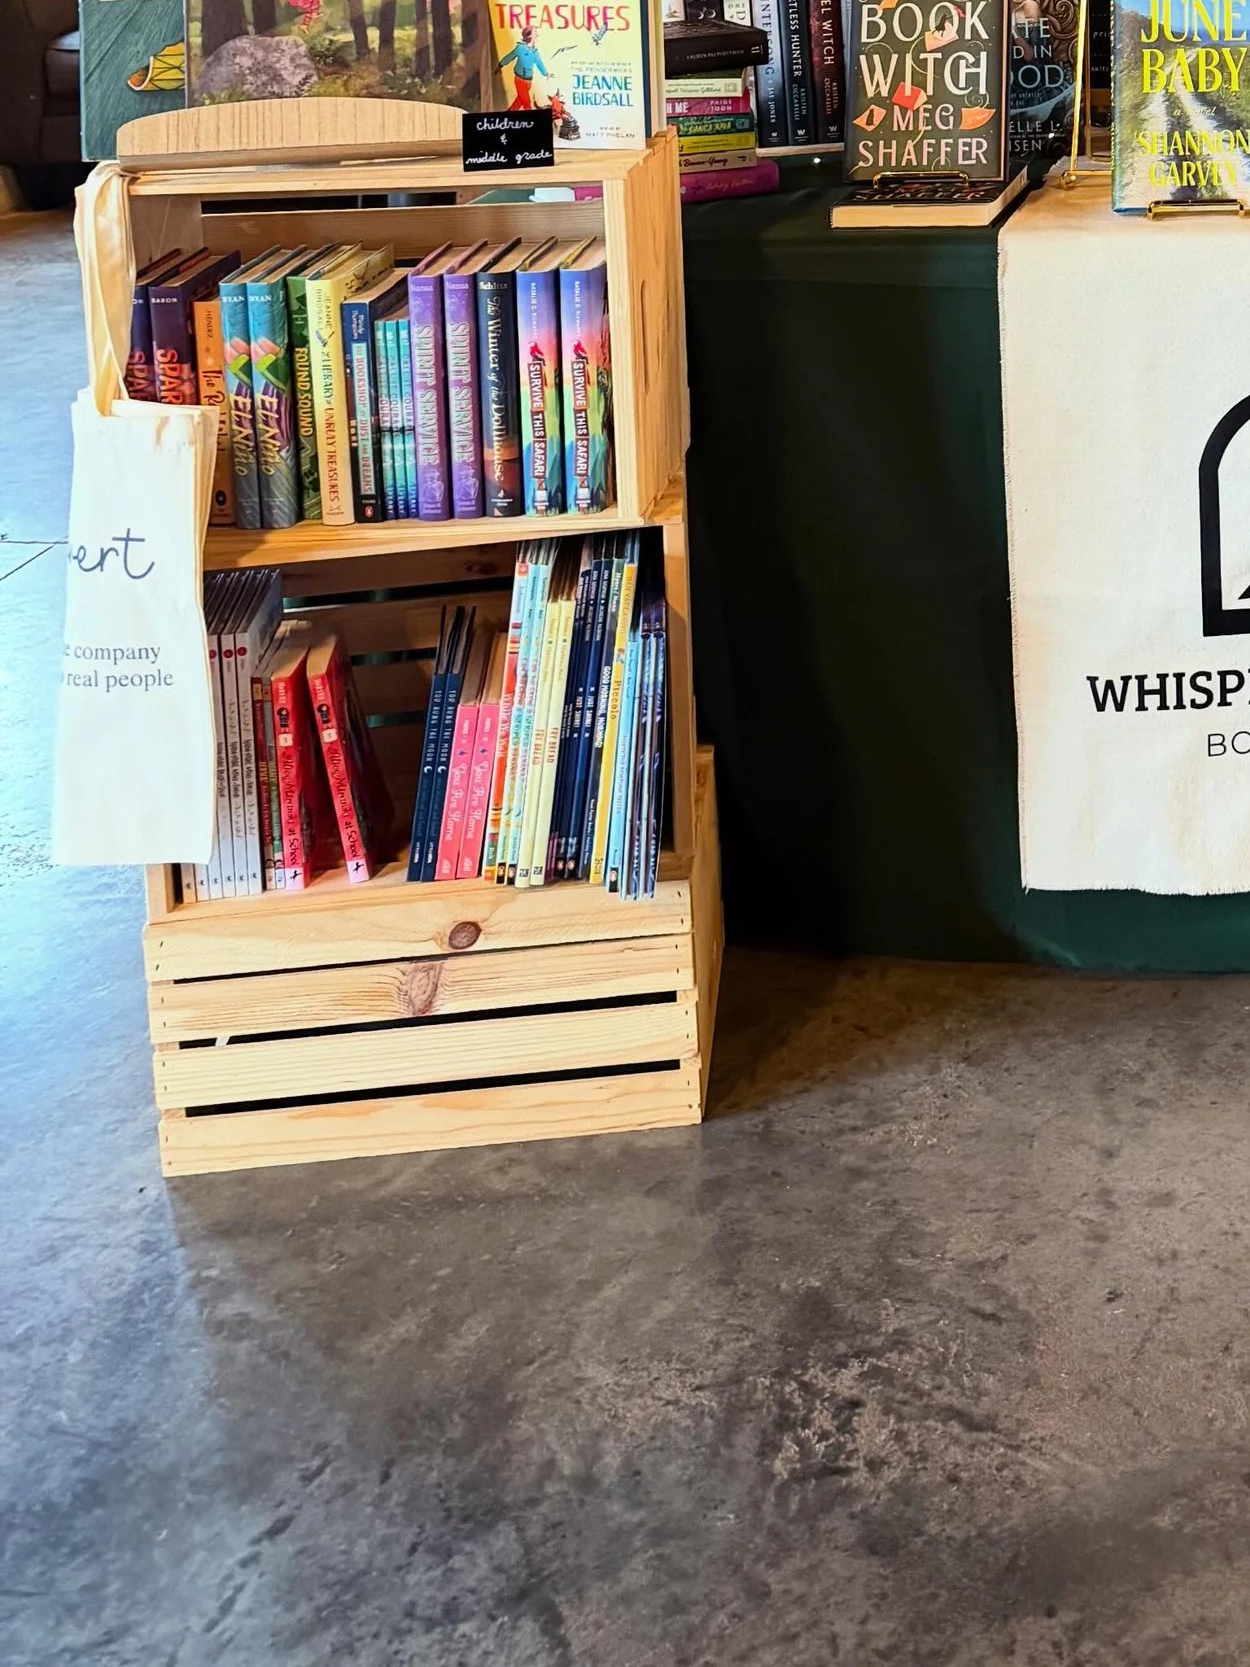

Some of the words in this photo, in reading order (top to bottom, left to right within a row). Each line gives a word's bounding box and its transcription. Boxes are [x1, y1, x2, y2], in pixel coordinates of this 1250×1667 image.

[495, 3, 631, 32] TREASURES
[860, 1, 990, 43] BOOK
[791, 34, 802, 76] HUNTER
[821, 20, 835, 66] WITCH
[572, 74, 633, 91] JEANNE
[858, 51, 988, 99] WITCH
[1141, 47, 1248, 95] BABY
[572, 92, 634, 107] BIRDSALL
[476, 118, 535, 130] children
[892, 103, 954, 132] MEG
[465, 151, 509, 164] middle
[515, 150, 552, 164] grade
[857, 137, 988, 167] SHAFFER
[1136, 129, 1250, 157] SHANNON
[1150, 160, 1237, 187] GARVEY
[488, 318, 502, 371] Winter
[295, 347, 311, 390] FOUND
[487, 373, 500, 382] of
[529, 365, 543, 408] SURVIVE
[573, 362, 586, 407] SURVIVE
[297, 393, 313, 437] SOUND
[324, 407, 337, 449] UNRULY
[533, 413, 544, 437] THIS
[576, 411, 587, 435] THIS
[490, 403, 505, 482] Dollhouse
[576, 440, 589, 474] SAFARI
[534, 442, 546, 476] SAFARI
[327, 449, 339, 502] TREASURES
[73, 644, 162, 662] company
[66, 670, 99, 688] real
[105, 669, 174, 692] people
[609, 679, 622, 721] Piccolo
[452, 763, 466, 785] You
[473, 761, 489, 782] You
[449, 789, 464, 808] Are
[470, 786, 486, 807] Are
[444, 811, 461, 842] Home
[465, 809, 483, 839] Home
[289, 837, 300, 866] School
[346, 831, 358, 858] School
